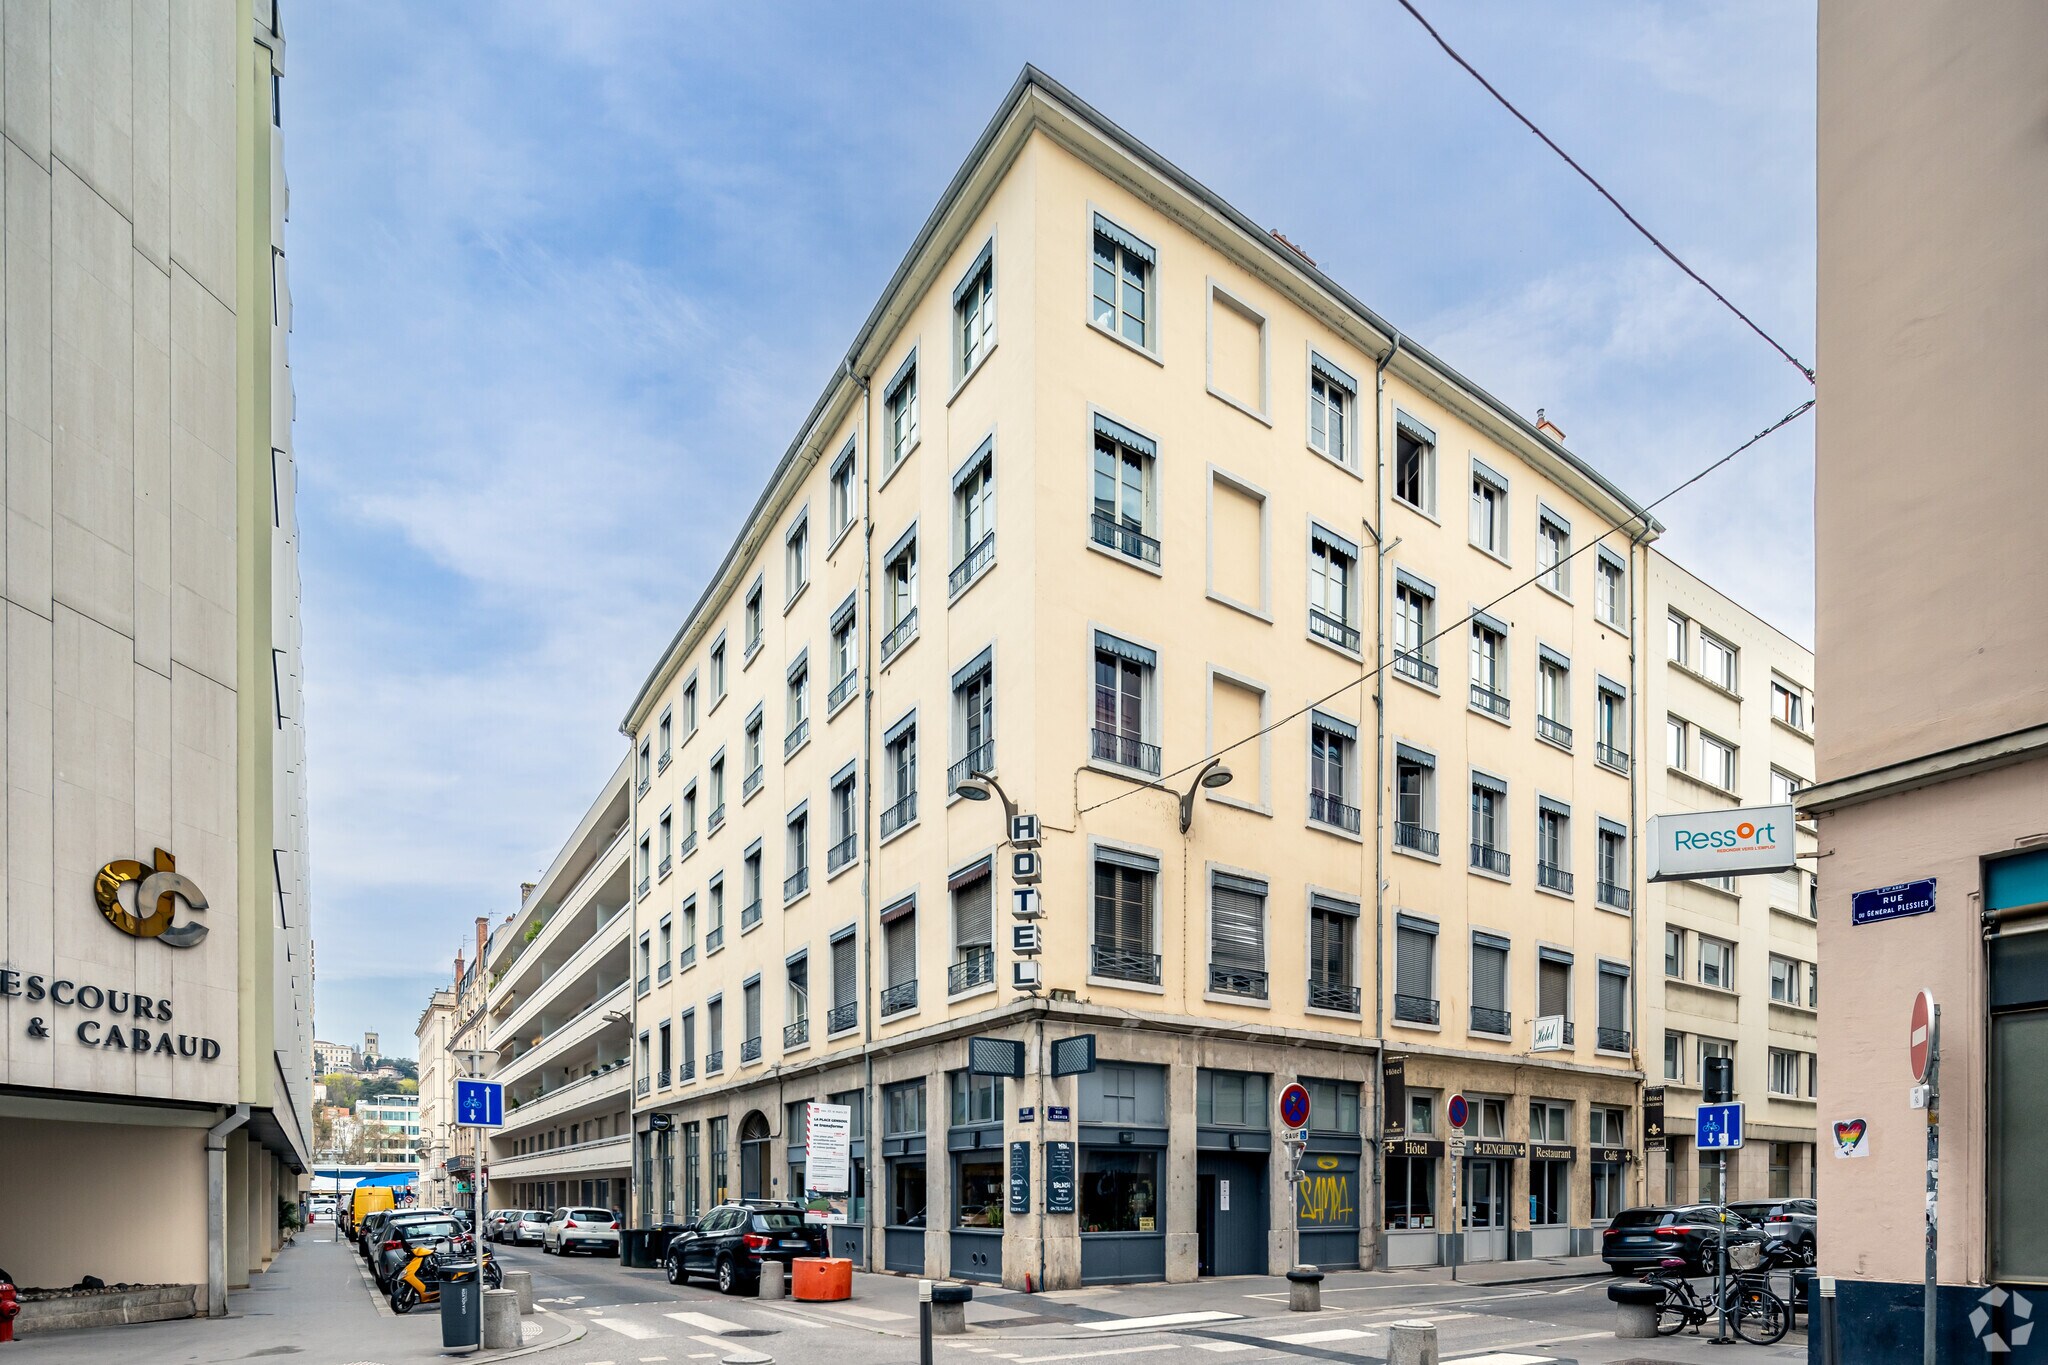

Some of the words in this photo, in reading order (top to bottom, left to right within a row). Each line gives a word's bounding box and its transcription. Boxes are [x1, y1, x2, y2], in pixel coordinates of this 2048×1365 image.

[1674, 822, 1776, 851] Ressort
[1013, 816, 1035, 985] HOTEL
[1883, 894, 1904, 905] RUE
[1866, 907, 1895, 918] GÉNÉRAL
[1897, 899, 1930, 912] PLESSIER
[0, 968, 174, 1022] ESCOURS
[27, 1016, 50, 1038] &
[77, 1020, 221, 1060] CABAUD
[1385, 1067, 1402, 1076] Hôtel
[1284, 1132, 1299, 1140] SAUF
[1404, 1141, 1428, 1155] Hôtel
[1482, 1143, 1518, 1156] L'ENGHIEN
[1535, 1147, 1572, 1160] Restaurant
[1603, 1150, 1618, 1162] Café
